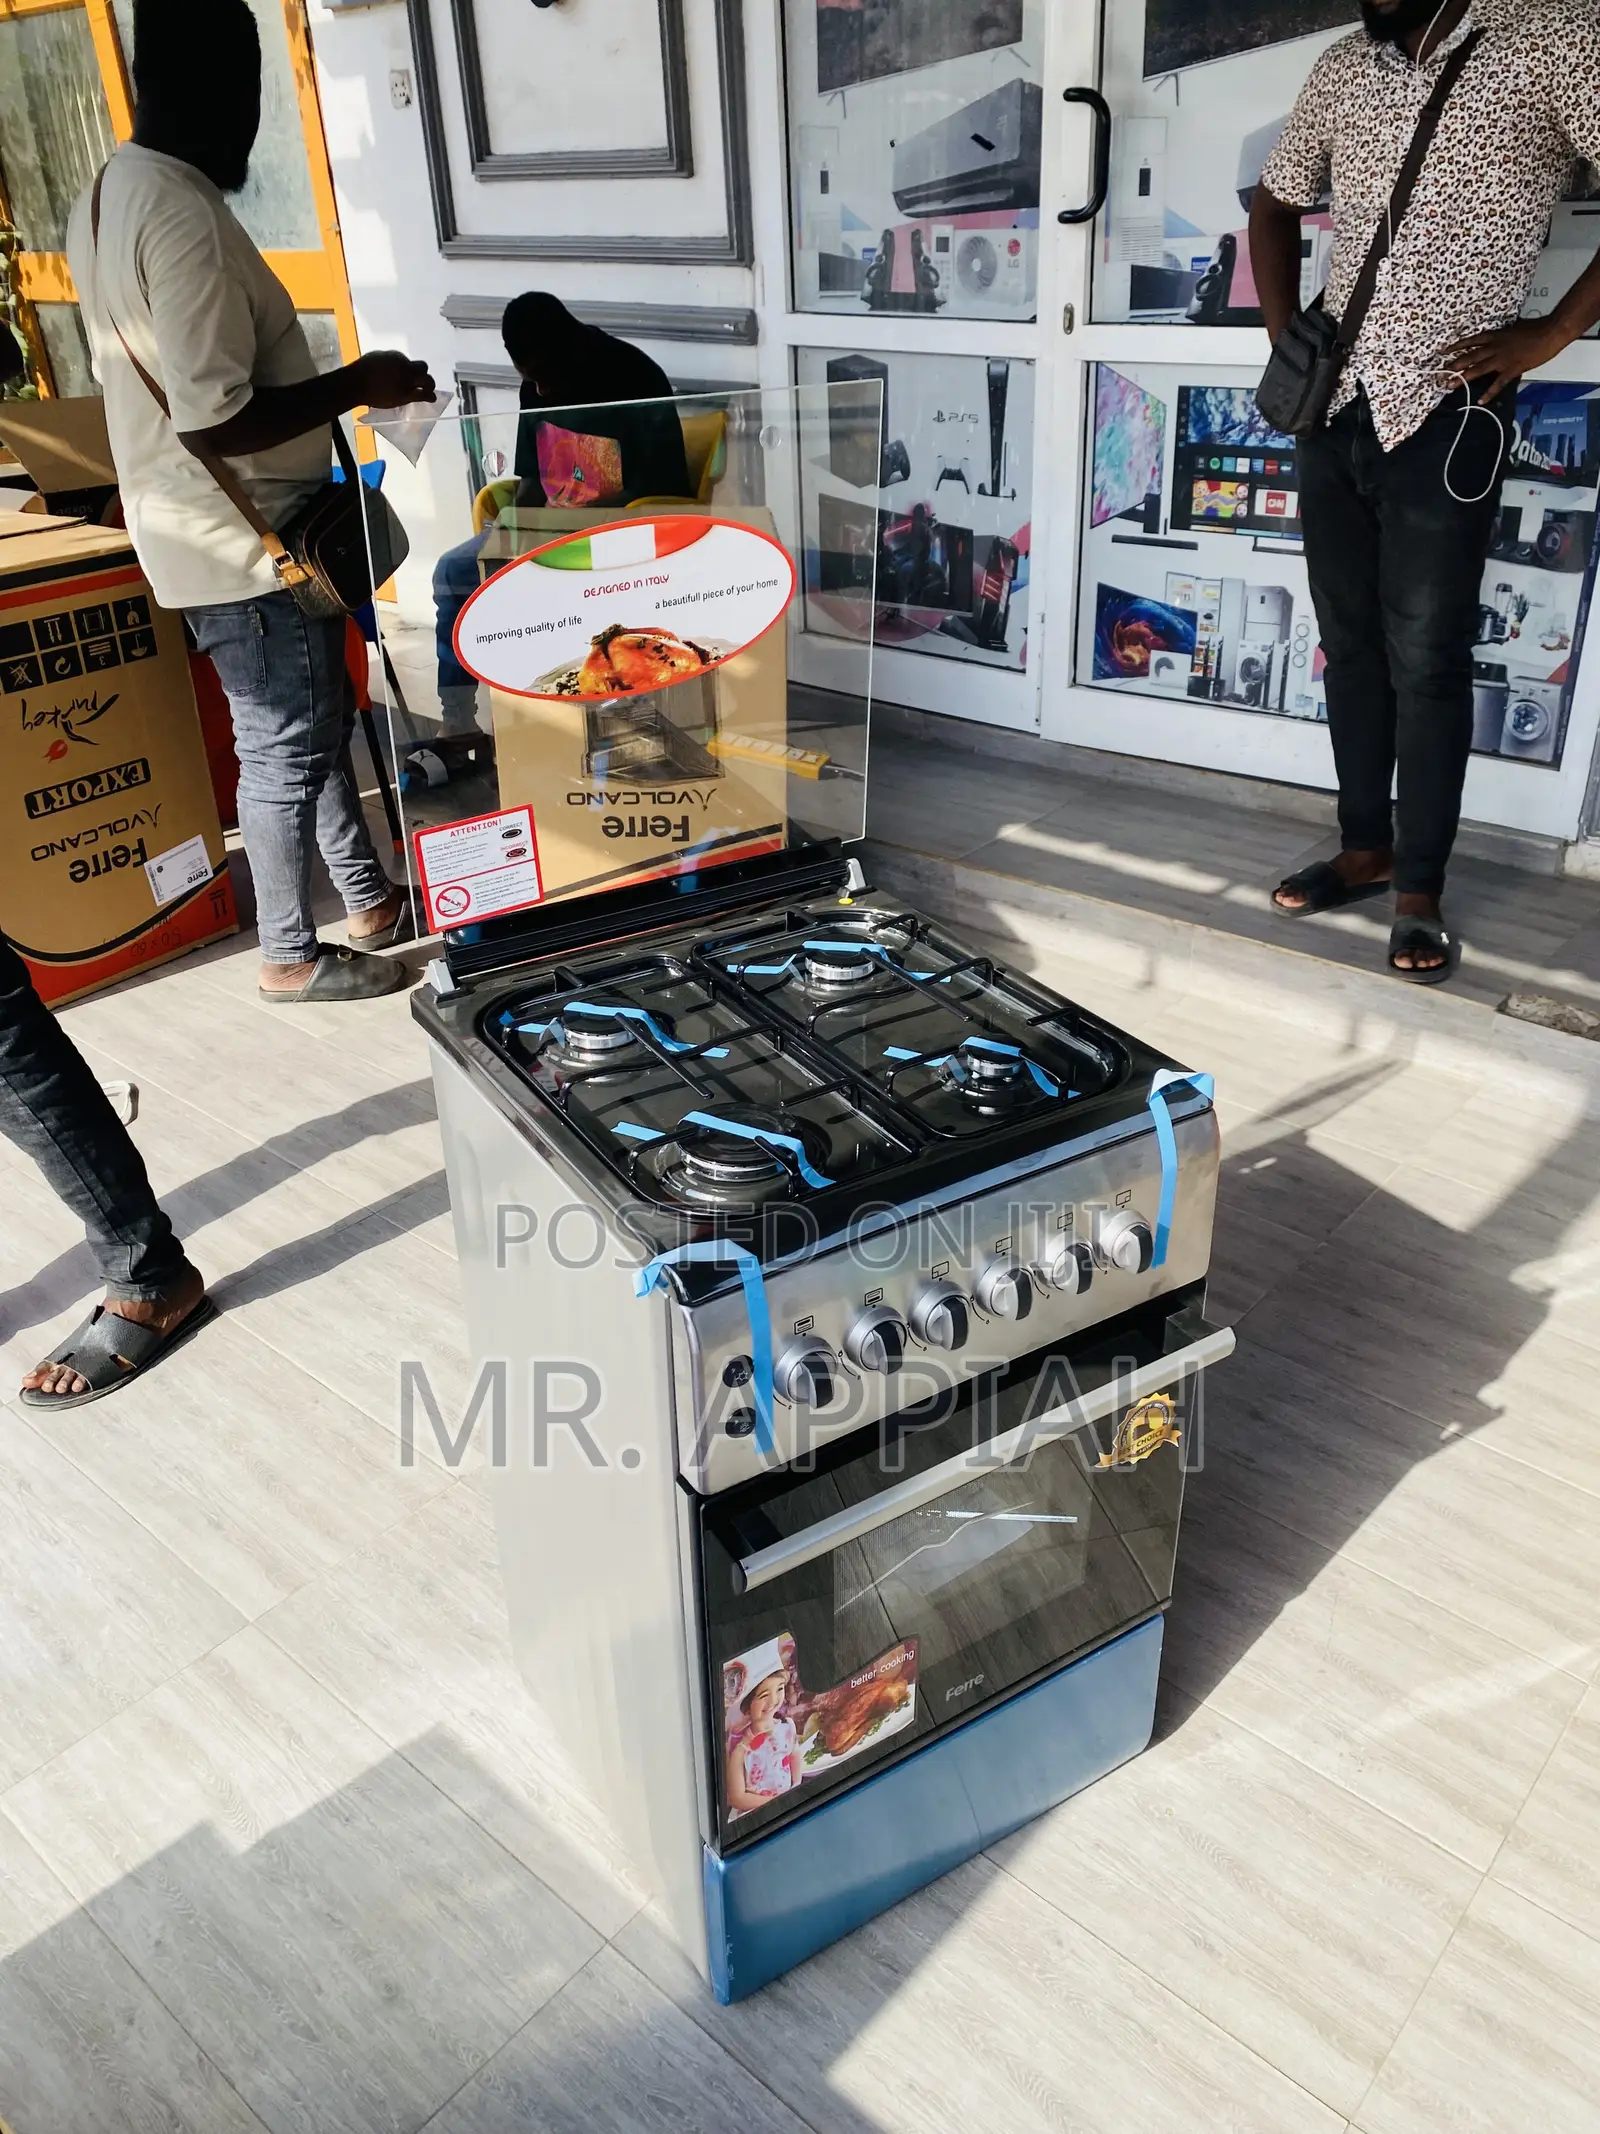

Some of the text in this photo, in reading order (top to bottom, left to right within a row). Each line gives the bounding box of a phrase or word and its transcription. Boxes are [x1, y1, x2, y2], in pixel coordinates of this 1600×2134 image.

[948, 412, 979, 424] PS5
[655, 577, 779, 610] a beautifull piece of your home
[476, 615, 583, 644] improving quality of life
[32, 760, 147, 816] EXPORT
[566, 791, 695, 806] VOLCANO
[31, 813, 146, 862] VOLCANO
[449, 818, 502, 838] ATTENTION!
[498, 821, 523, 832] CORRECT
[601, 815, 690, 842] Ferre
[69, 837, 149, 884] Ferre
[187, 868, 208, 884] Ferre
[850, 1650, 915, 1689] better cooking
[945, 1673, 985, 1702] Ferre
